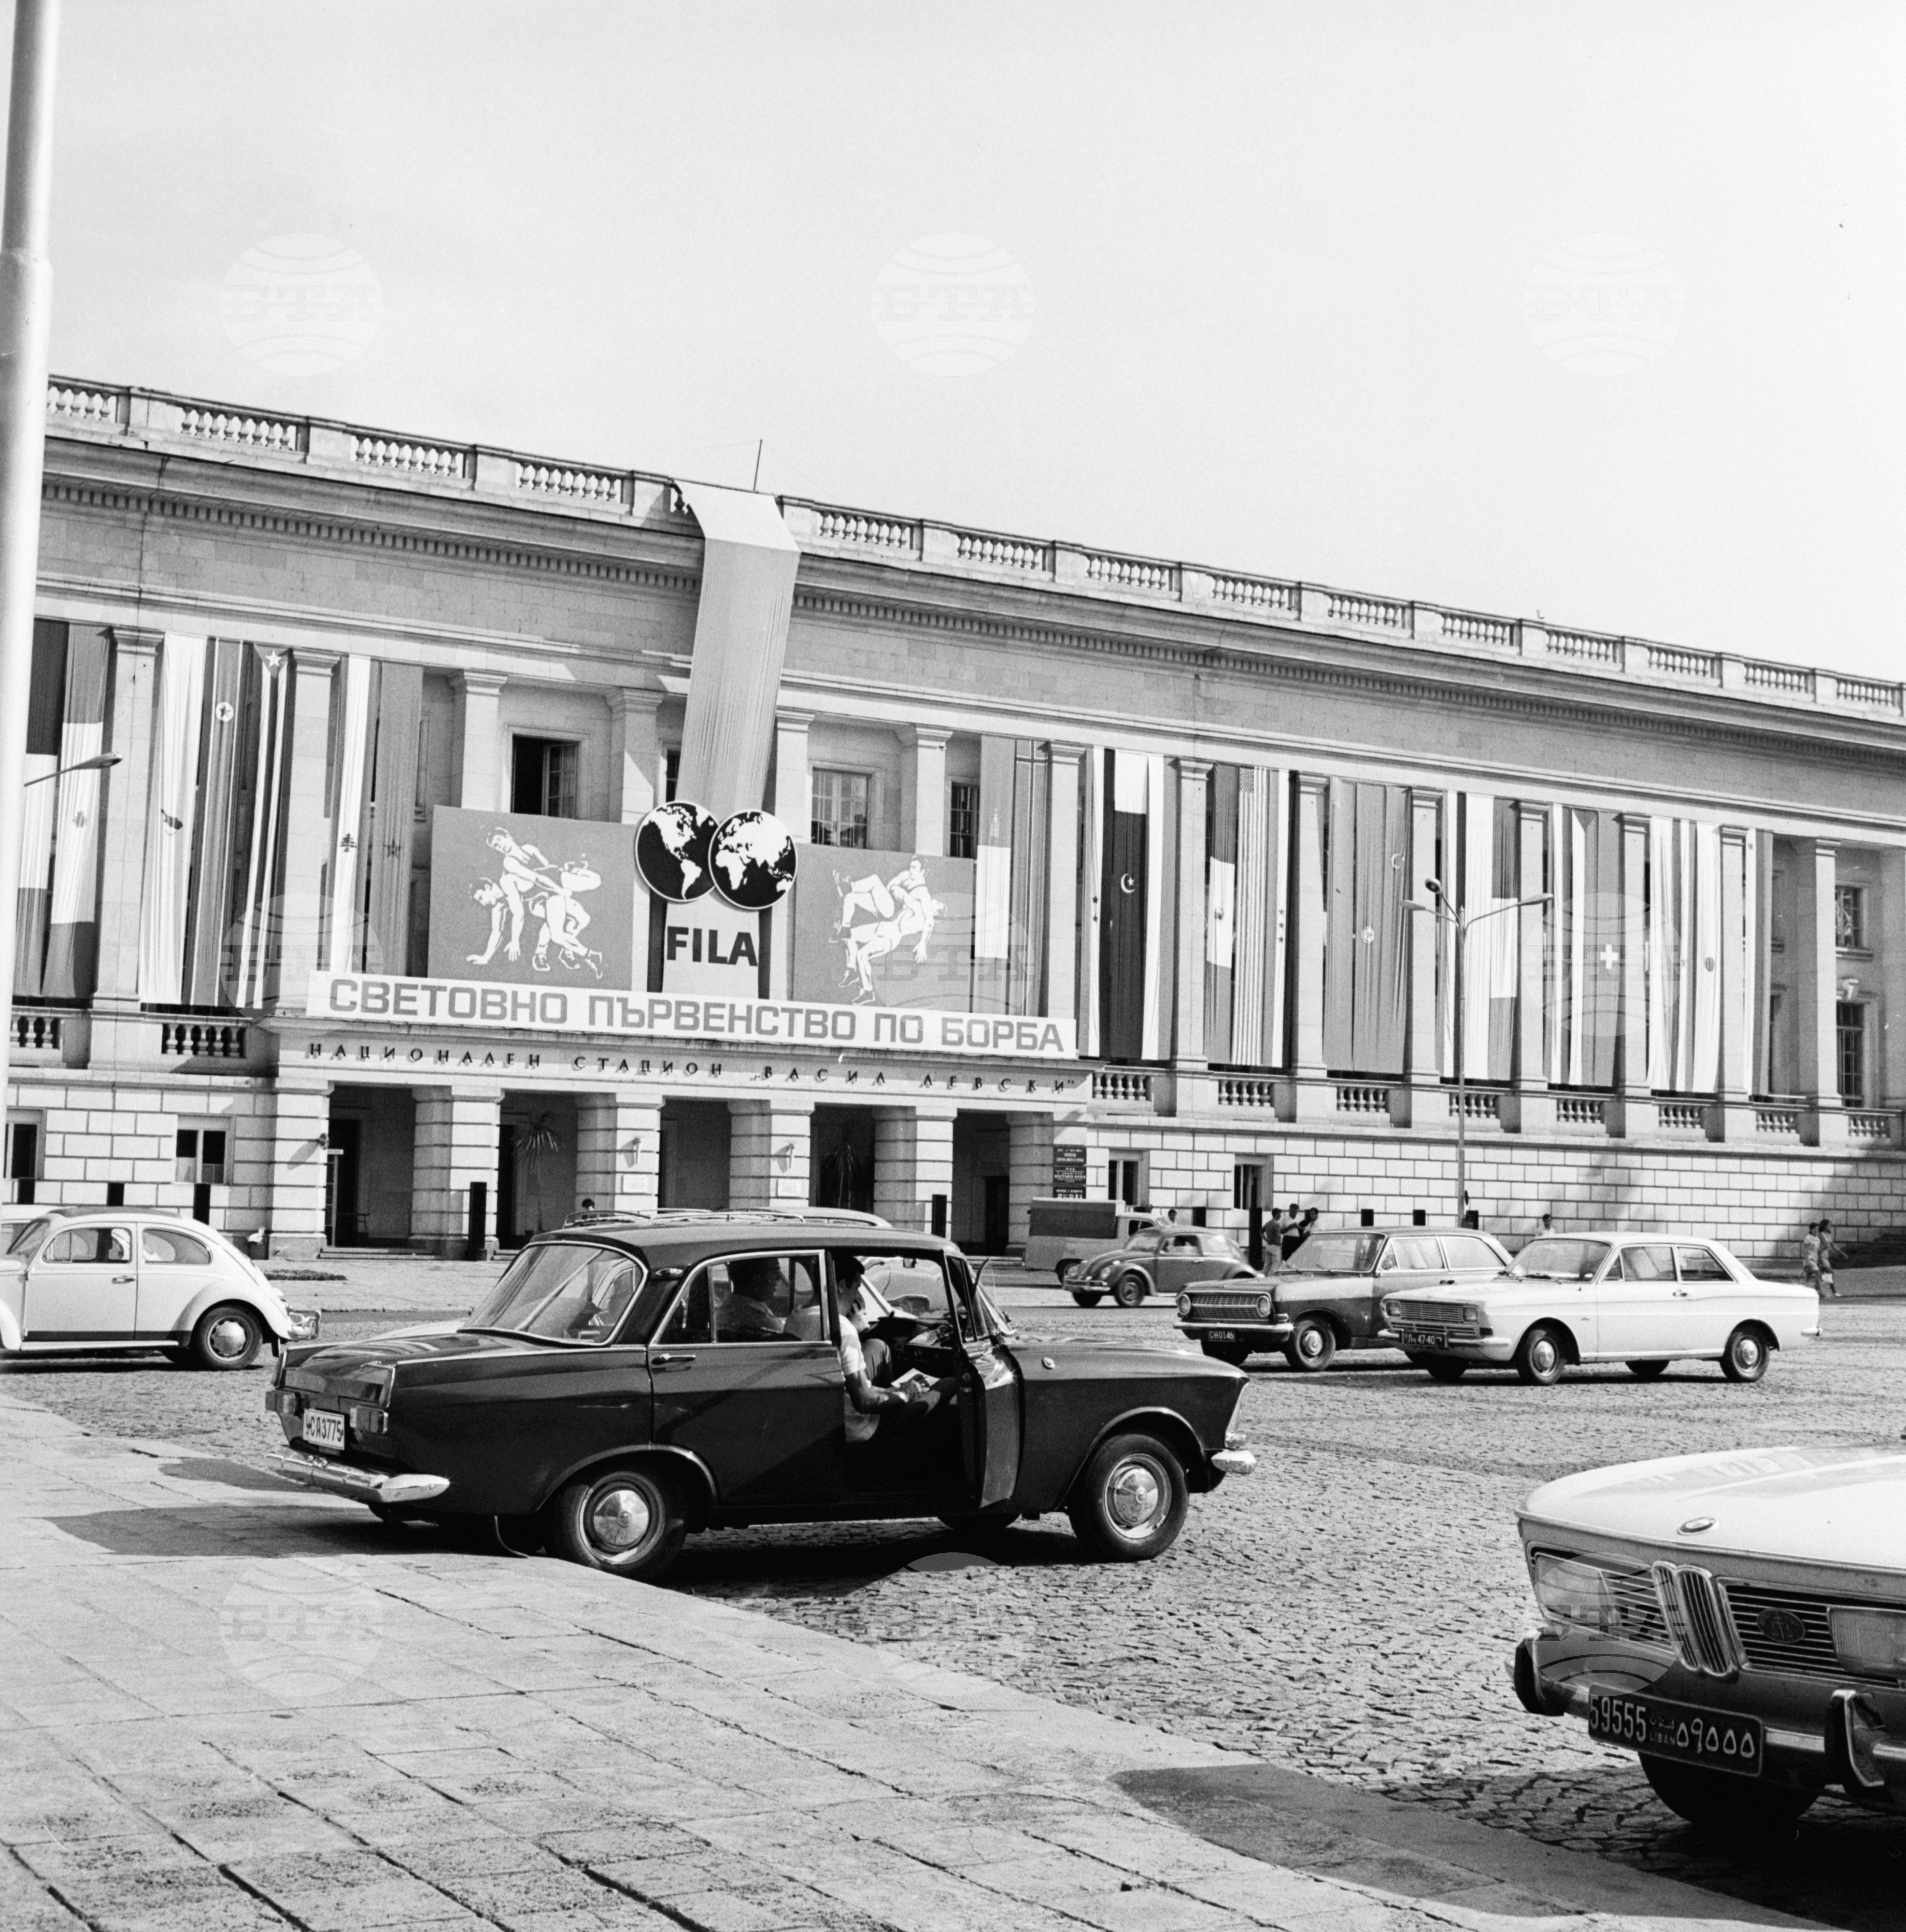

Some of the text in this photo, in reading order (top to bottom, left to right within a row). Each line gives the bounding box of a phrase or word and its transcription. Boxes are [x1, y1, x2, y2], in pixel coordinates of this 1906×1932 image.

[667, 926, 758, 966] FILA
[329, 979, 1065, 1052] СВЕТОВНО ПЪРВЕНСТВО ПО БОРБА
[310, 1043, 541, 1067] НАЦИОНАЛЕН
[574, 1056, 722, 1076] СТАДИОН
[1590, 1695, 1646, 1742] 59555
[1650, 1731, 1676, 1746] LIBAN
[1677, 1718, 1755, 1758] ٥٩٥٥٥
